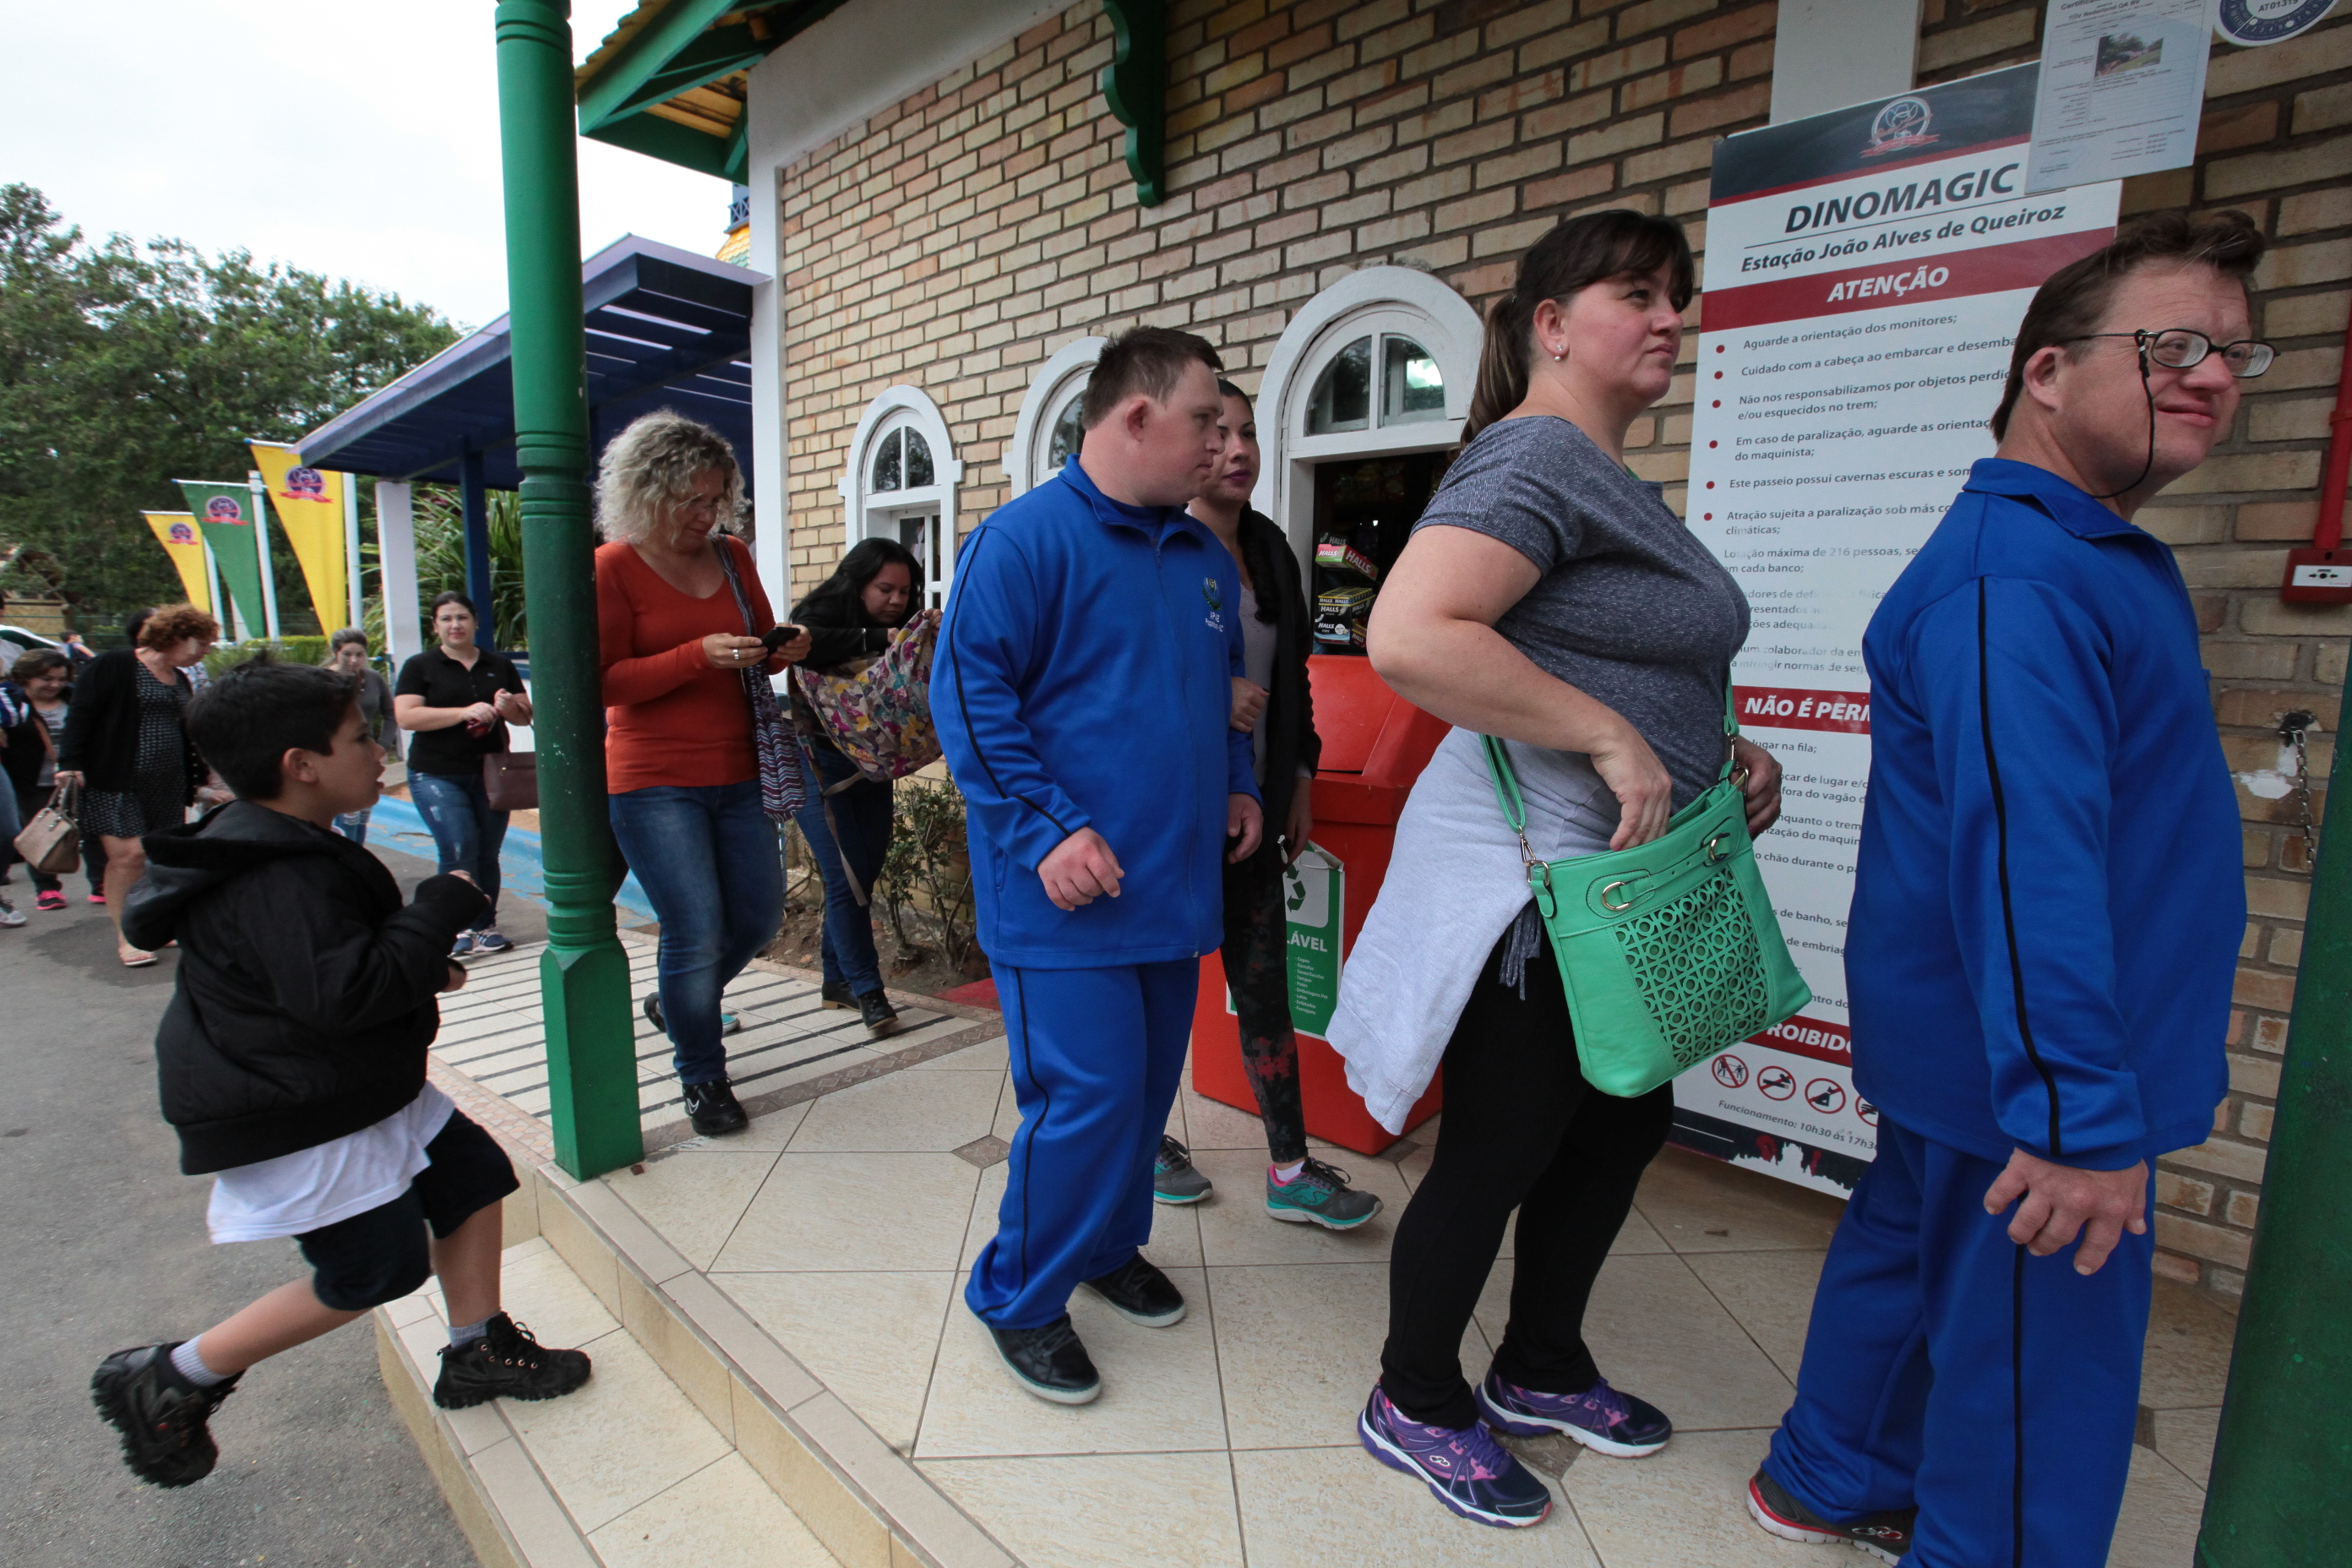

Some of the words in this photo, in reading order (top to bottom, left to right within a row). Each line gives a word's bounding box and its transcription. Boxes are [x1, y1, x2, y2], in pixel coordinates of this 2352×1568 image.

[1784, 162, 2020, 234] DINOMAGIC
[1740, 247, 1816, 273] Estação
[1819, 238, 1869, 260] João
[1872, 229, 1931, 250] Alves
[1937, 221, 1964, 239] de
[1970, 206, 2066, 234] Queiroz
[1827, 264, 1950, 302] ATENÇÃO
[1744, 335, 1788, 351] Aguarde
[1801, 327, 1862, 341] orientação
[1865, 324, 1886, 333] dos
[1889, 313, 1957, 330] monitores;
[1742, 363, 1785, 375] Cuidado
[1824, 356, 1864, 367] cabeça
[1885, 346, 1943, 359] embarcar
[1740, 395, 1760, 404] Não
[1784, 382, 1891, 401] responsabilizamos
[1894, 381, 1915, 391] por
[1918, 375, 1966, 388] objetos
[1738, 411, 1761, 420] e/ou
[1765, 405, 1826, 418] esquecidos
[1847, 400, 1877, 411] trem;
[1781, 433, 1794, 442] de
[1798, 428, 1864, 443] paralização,
[1868, 423, 1917, 438] aguarde
[1735, 452, 1748, 460] do
[1751, 449, 1814, 460] maquinista;
[1754, 476, 1793, 488] passeio
[1796, 474, 1831, 486] possui
[1835, 473, 1885, 482] cavernas
[1889, 471, 1934, 479] escuras
[1727, 511, 1767, 521] Atração
[1770, 509, 1805, 520] sujeita
[1817, 506, 1882, 519] paralização
[1886, 504, 1907, 514] sob
[1910, 504, 1935, 513] más
[1726, 525, 1780, 536] climáticas;
[1329, 536, 1347, 545] HALLS
[1724, 549, 1764, 559] Loção
[1767, 548, 1809, 557] máxima
[1812, 547, 1827, 557] de
[1829, 547, 1850, 557] 216
[1853, 547, 1902, 558] pessoas,
[1345, 550, 1370, 574] HALLS
[1768, 564, 1804, 573] banco;
[1779, 590, 1794, 599] de
[1353, 603, 1364, 612] HALLS
[1352, 633, 1364, 643] HALLS
[1764, 645, 1827, 656] colaborador
[1831, 647, 1844, 656] da
[1784, 662, 1825, 671] normas
[1828, 662, 1842, 672] de
[1745, 695, 1794, 716] NÃO
[1798, 694, 1813, 717] É
[1798, 743, 1816, 754] fila;
[1804, 774, 1816, 783] de
[1820, 776, 1848, 787] lugar
[1782, 787, 1802, 797] fora
[1805, 790, 1819, 798] do
[1823, 793, 1856, 803] vagão
[1835, 820, 1861, 830] trem
[1802, 830, 1816, 839] do
[1764, 853, 1788, 863] chão
[1792, 857, 1834, 869] durante
[1780, 909, 1793, 917] de
[1796, 911, 1832, 925] banho,
[1787, 938, 1799, 946] de
[1719, 1101, 1797, 1128] Funcionamento:
[1801, 1123, 1831, 1137] 10h30
[1833, 1132, 1844, 1141] às
